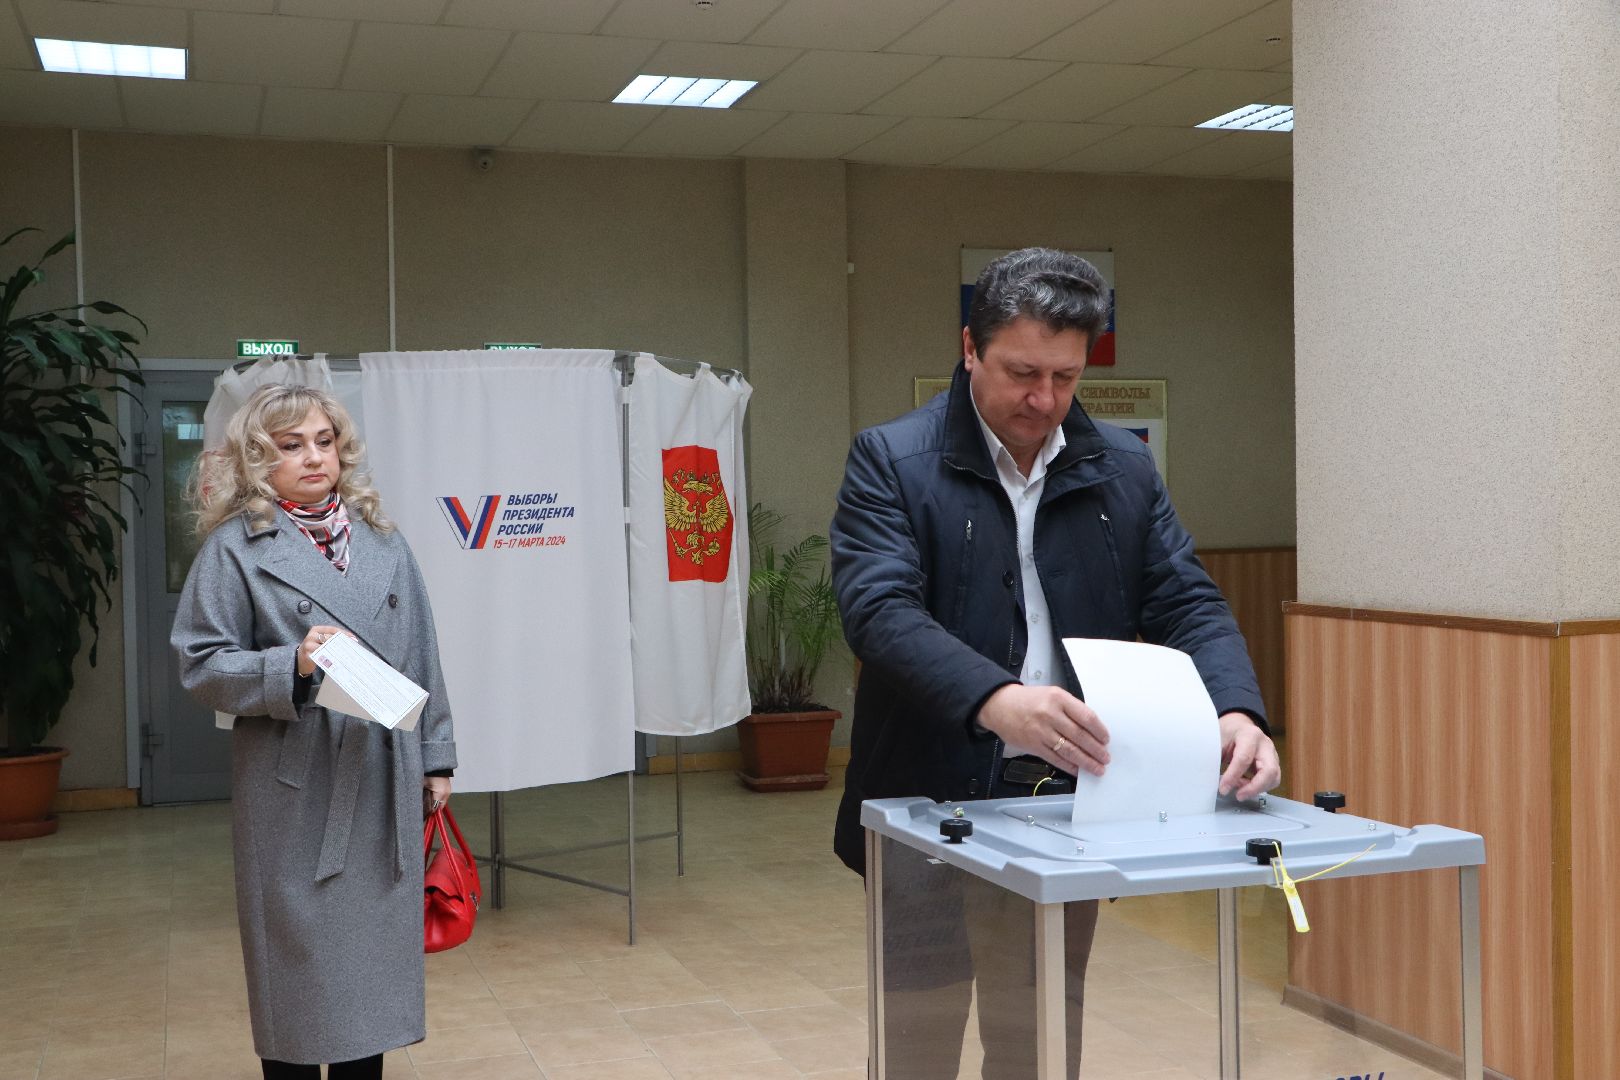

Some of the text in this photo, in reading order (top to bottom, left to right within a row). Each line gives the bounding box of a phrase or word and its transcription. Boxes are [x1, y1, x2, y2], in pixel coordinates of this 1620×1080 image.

[242, 342, 295, 355] ВЫХОД
[1080, 386, 1152, 400] СИМВОЛЫ
[507, 492, 558, 506] ВЫБОРЫ
[502, 506, 575, 521] ПРЕЗИДЕНТА
[497, 523, 544, 536] РОССИИ
[517, 536, 545, 549] МАРТА
[545, 535, 566, 546] 2024
